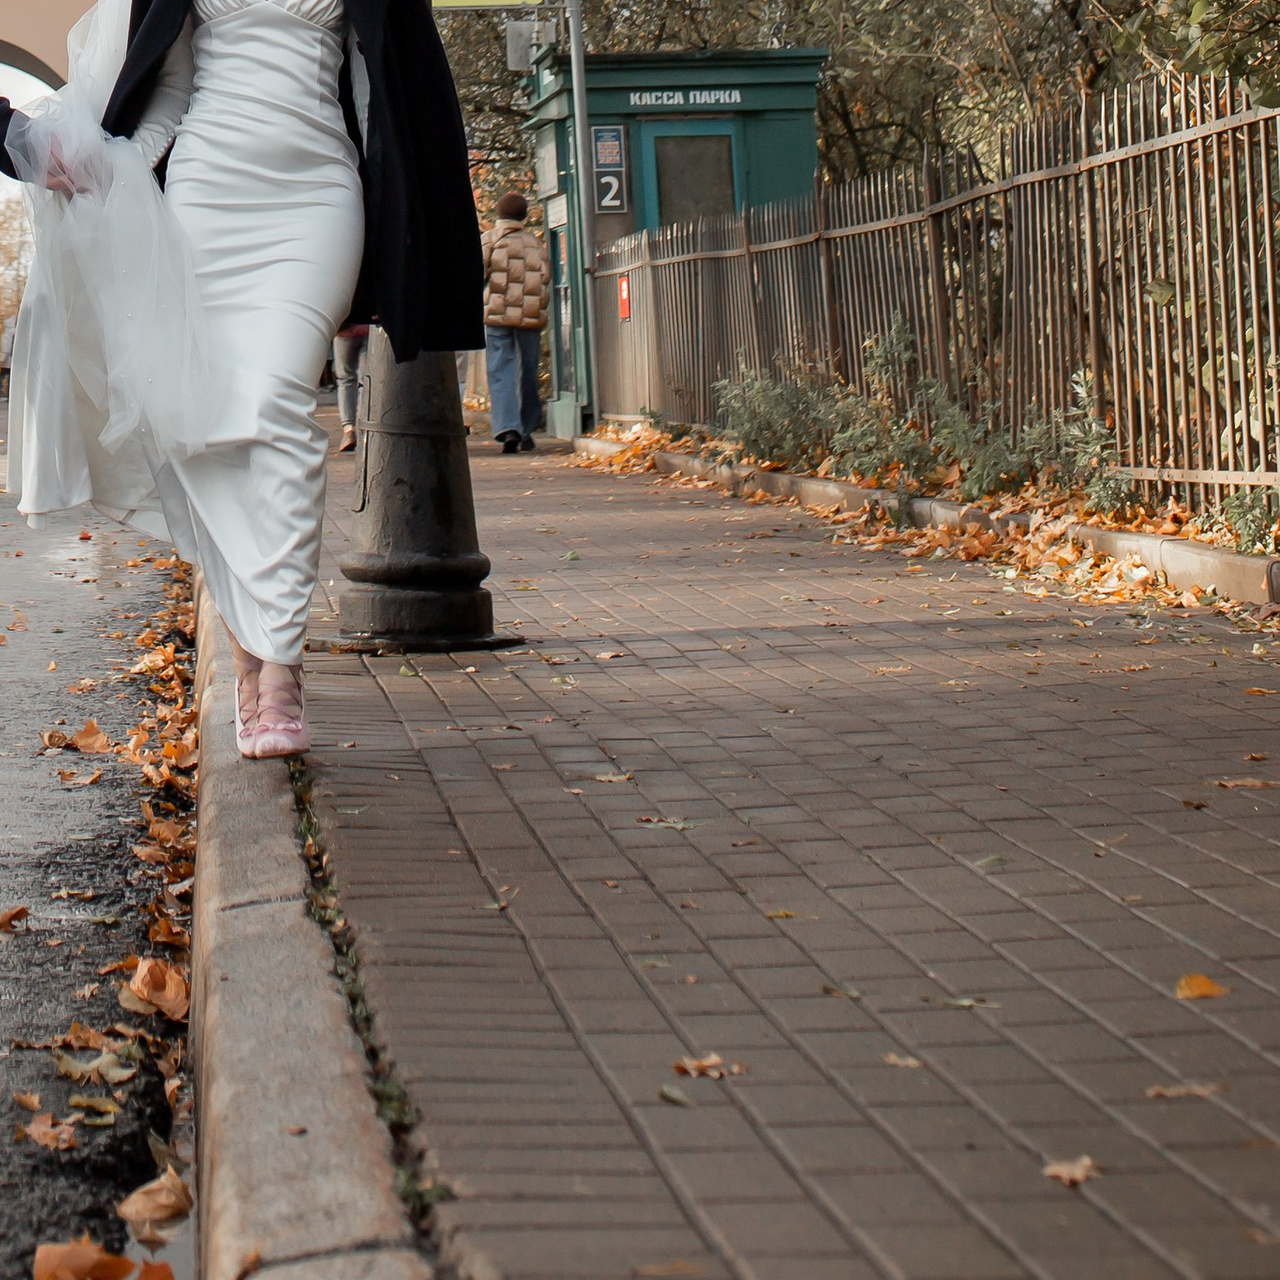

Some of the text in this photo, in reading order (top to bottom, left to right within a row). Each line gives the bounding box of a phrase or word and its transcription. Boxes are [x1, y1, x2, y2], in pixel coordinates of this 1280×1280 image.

[629, 89, 742, 106] КАССА ПАРКА
[600, 175, 621, 207] 2
